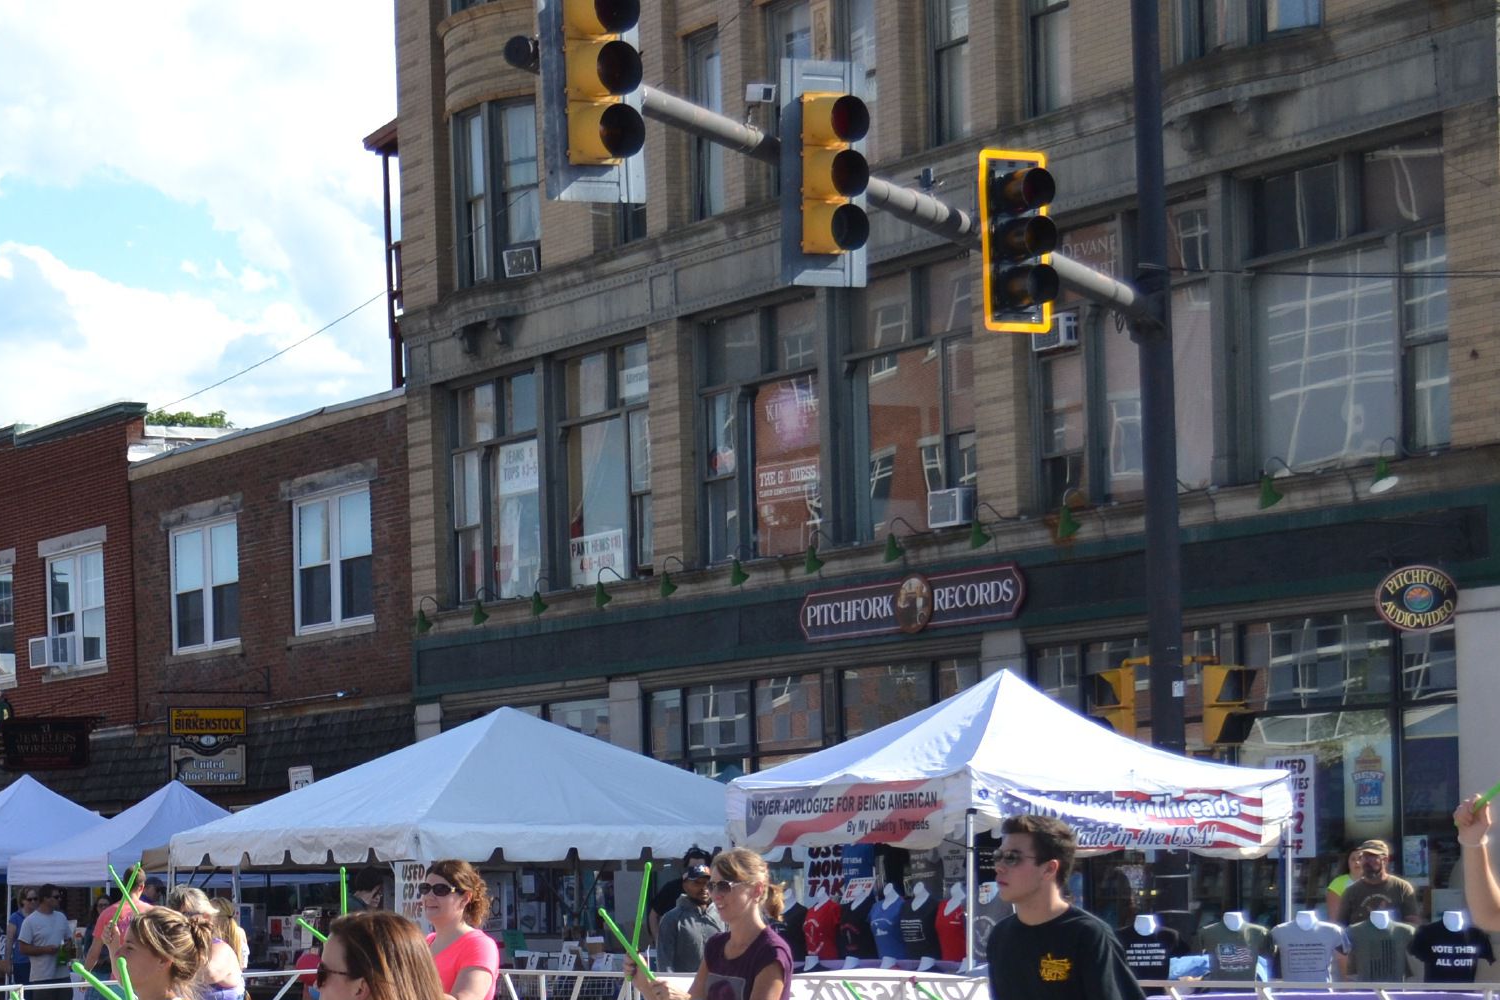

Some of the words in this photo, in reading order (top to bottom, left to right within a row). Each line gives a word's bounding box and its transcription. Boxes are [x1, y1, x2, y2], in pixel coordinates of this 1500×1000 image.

[759, 471, 776, 487] THE
[777, 465, 817, 484] GDDESS
[1385, 569, 1451, 595] PITCHFORK
[806, 594, 894, 628] PITCHFORK
[933, 578, 1014, 612] RECORDS
[174, 718, 242, 730] BIRKENSTOCK
[17, 744, 77, 753] WORKSHOP
[193, 760, 225, 769] United
[179, 772, 203, 781] Shoe
[206, 771, 239, 782] Repair
[751, 799, 781, 816] NEVER
[782, 796, 834, 815] APOLOGIZE
[836, 796, 855, 813] FOR
[857, 794, 886, 811] BEING
[888, 791, 938, 809] AMERICAN
[1150, 793, 1241, 821] Threads
[846, 820, 856, 835] By
[858, 820, 869, 835] My
[870, 819, 897, 834] Liberty
[899, 817, 930, 831] Threads
[1073, 824, 1112, 848] ade
[1113, 826, 1133, 846] in
[1137, 827, 1165, 846] the
[1171, 825, 1219, 847] USA!
[808, 845, 843, 859] USE
[401, 863, 425, 882] USED
[808, 877, 844, 897] TAK
[1431, 945, 1453, 954] VOTE
[1435, 958, 1452, 967] ALL
